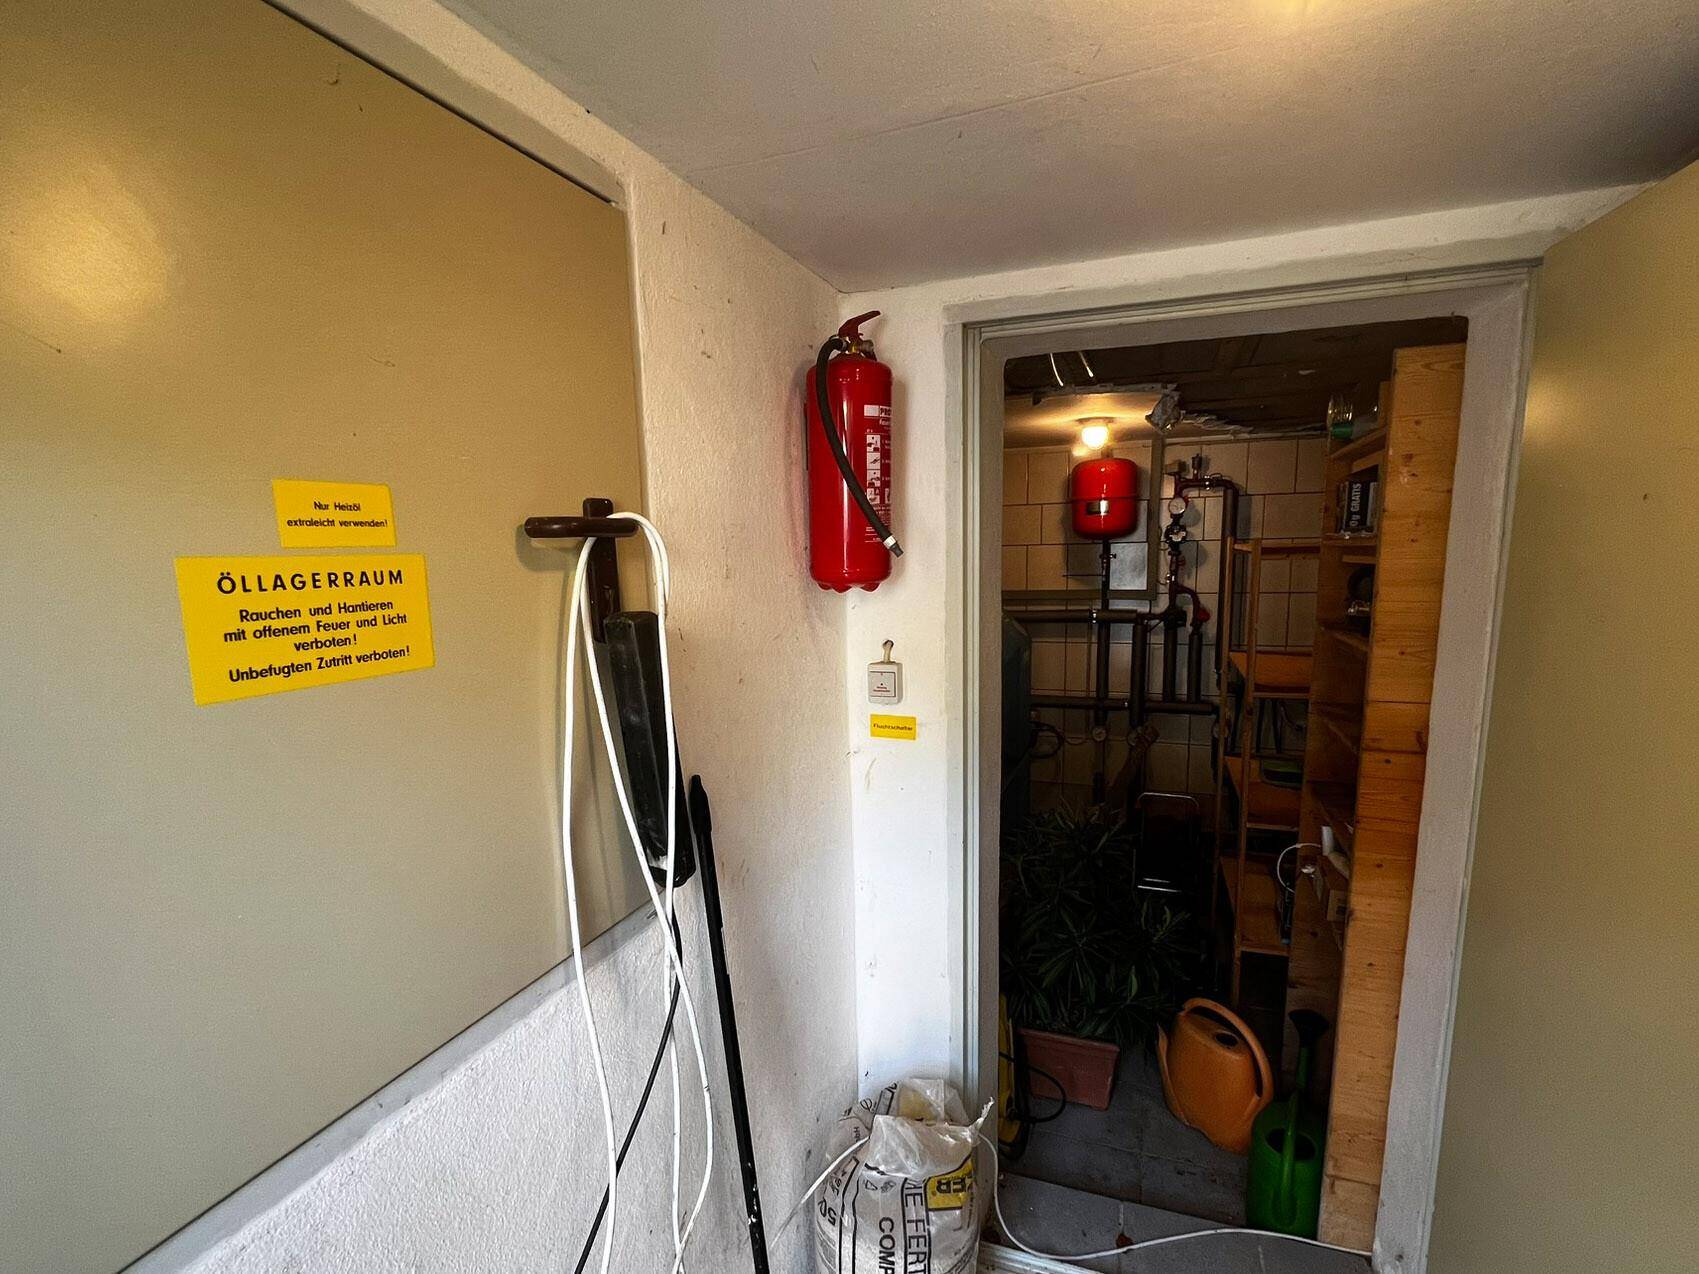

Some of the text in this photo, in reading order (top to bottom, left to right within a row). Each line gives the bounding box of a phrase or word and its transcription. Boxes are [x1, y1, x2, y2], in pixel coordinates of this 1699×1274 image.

[314, 501, 361, 512] Nur Heizöl
[1350, 483, 1362, 512] GRATIS
[286, 518, 388, 528] extraleicht verwenden!
[216, 569, 404, 595] ÖLLAGERRAUM
[239, 600, 394, 623] Rauchen und Hantieren
[223, 613, 407, 643] mit offenem Feuer und Licht
[294, 634, 358, 652] verboten!
[228, 645, 411, 682] Unbefugten Zutritt verboten!
